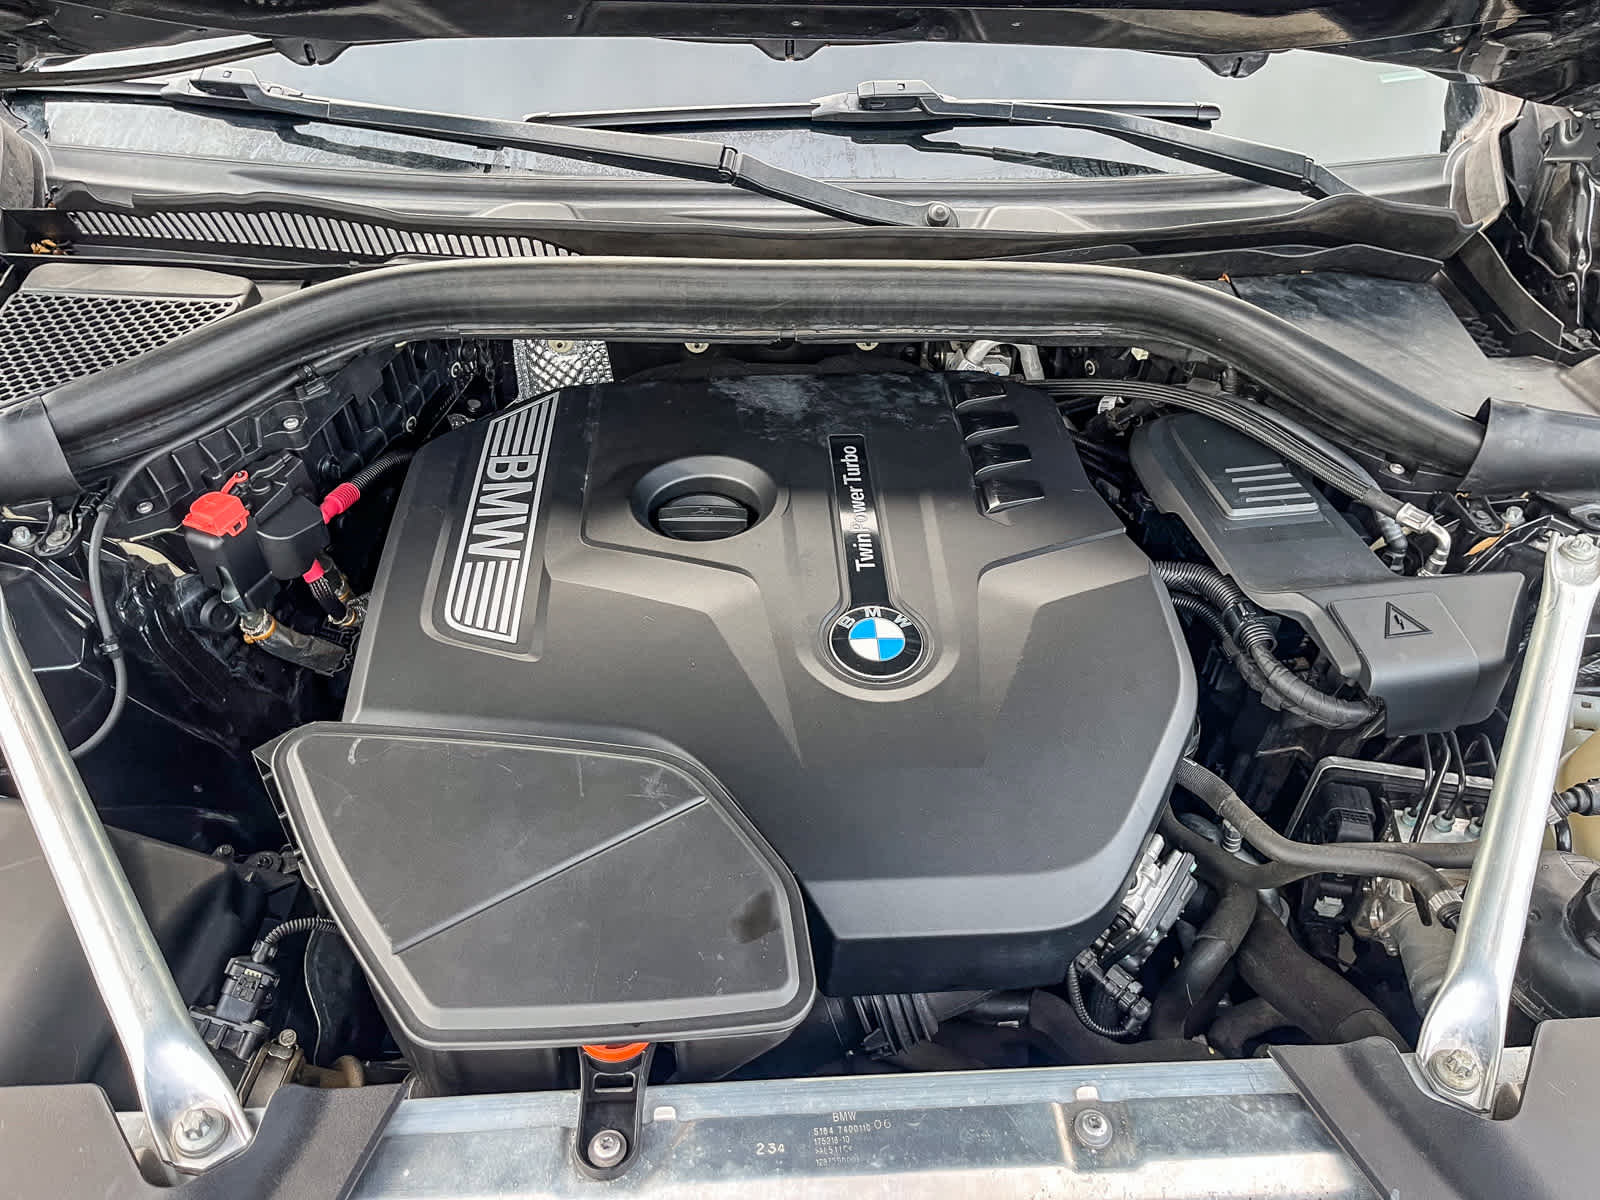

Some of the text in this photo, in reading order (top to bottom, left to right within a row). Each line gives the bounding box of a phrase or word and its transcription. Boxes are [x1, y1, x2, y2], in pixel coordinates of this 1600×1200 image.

[467, 454, 539, 559] BMW
[840, 445, 876, 572] TwinPower Turbo
[838, 605, 913, 630] BMW
[832, 1111, 857, 1122] BMW
[756, 1142, 785, 1156] 234
